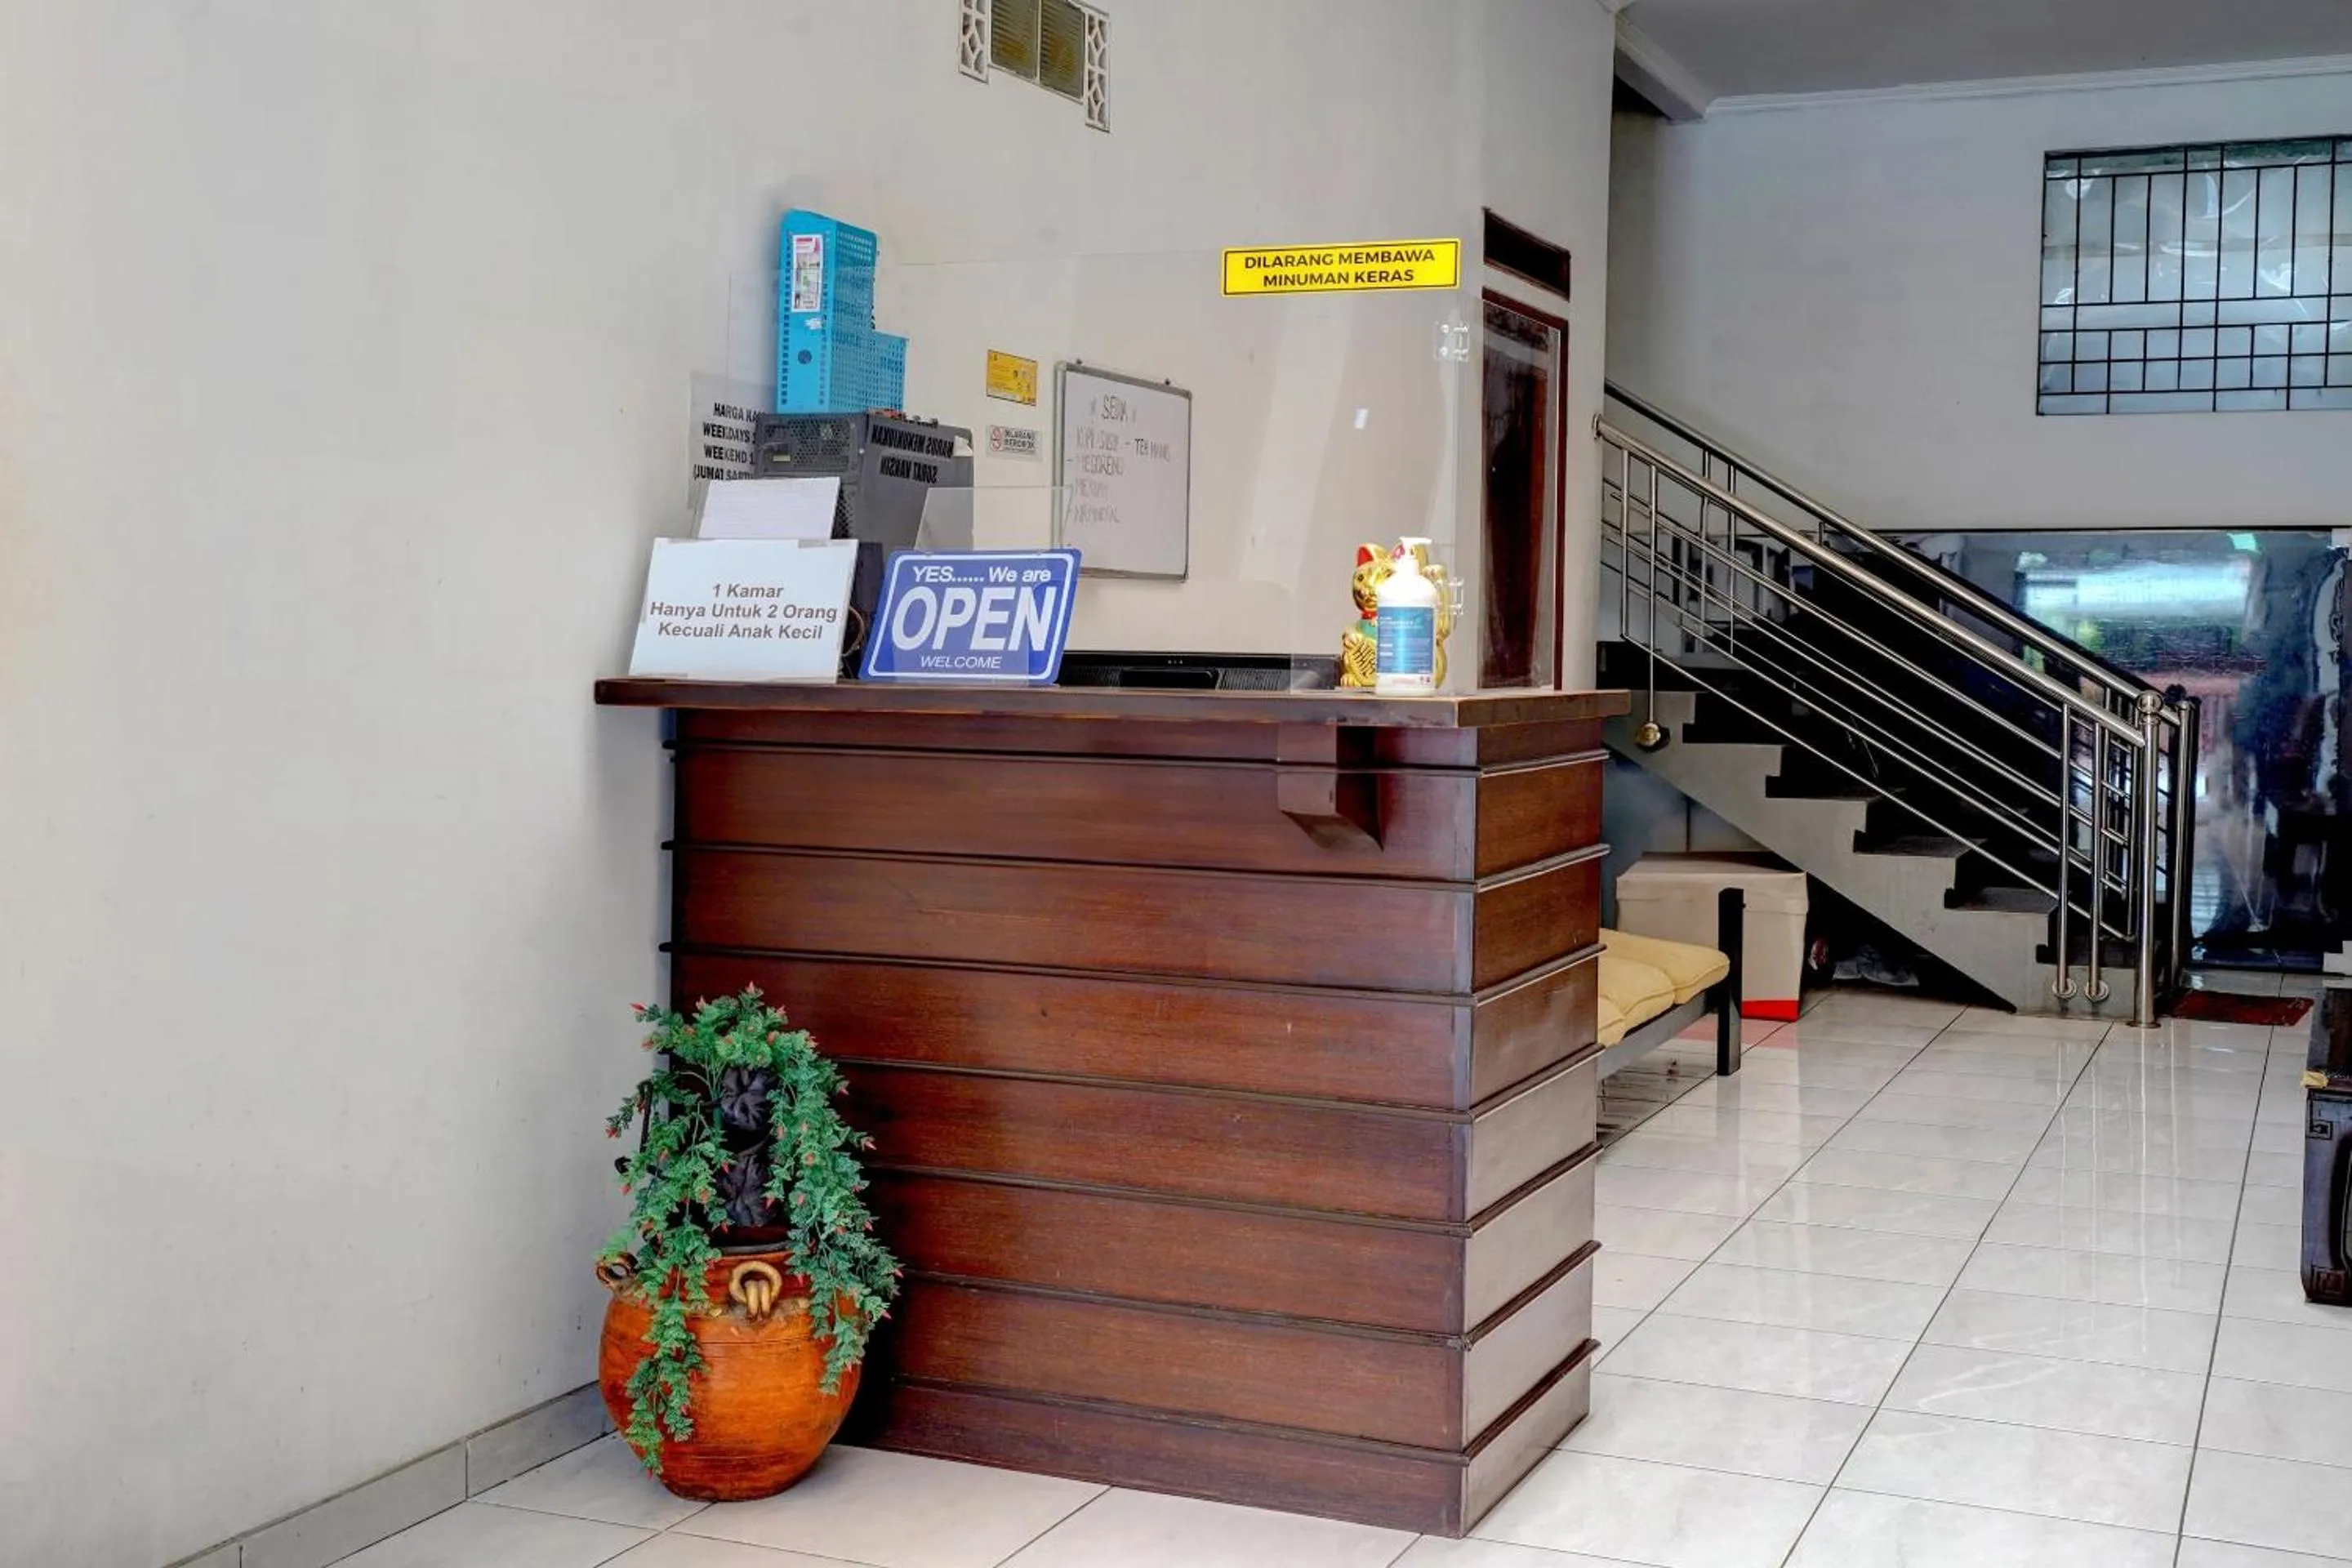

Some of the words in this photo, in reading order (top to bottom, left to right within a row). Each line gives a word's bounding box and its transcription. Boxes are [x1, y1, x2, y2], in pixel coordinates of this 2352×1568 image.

[1244, 252, 1334, 270] DILARANG
[1338, 248, 1436, 265] MEMBAWA
[1263, 271, 1349, 287] MINUMAN
[1354, 269, 1415, 284] KERAS
[713, 402, 744, 421] HARGA
[703, 443, 746, 464] WEEKEND
[988, 566, 1018, 582] We
[1022, 567, 1052, 582] are
[712, 583, 720, 598] 1
[727, 583, 784, 599] Kamar
[650, 601, 706, 621] Hanya
[711, 603, 761, 619] Untuk
[767, 604, 778, 619] 2
[783, 604, 838, 623] Orang
[892, 586, 1057, 651] OPEN
[658, 622, 724, 639] Kecuali
[728, 624, 773, 639] Anak
[778, 625, 822, 640] Kecil
[920, 656, 1003, 670] WELCOME
